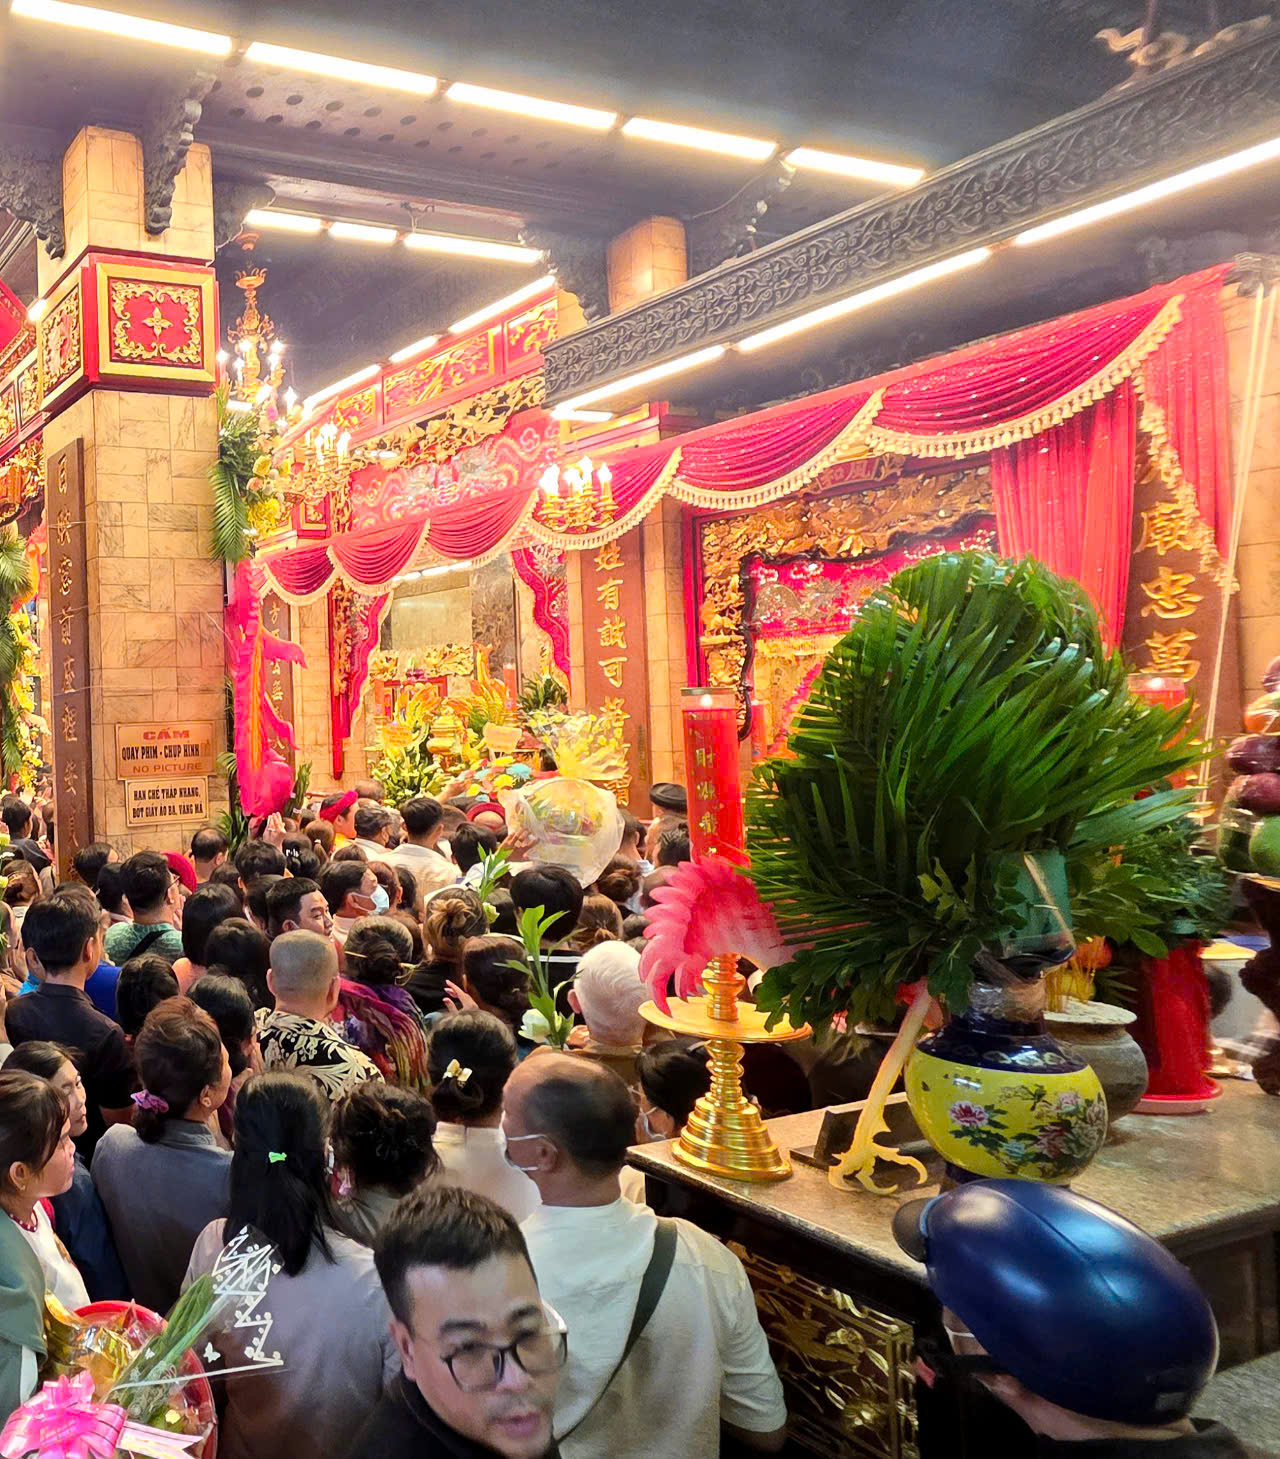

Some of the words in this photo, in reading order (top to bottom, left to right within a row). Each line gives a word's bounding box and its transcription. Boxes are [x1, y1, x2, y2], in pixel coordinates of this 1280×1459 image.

[143, 727, 190, 740] CẤM
[122, 746, 140, 760] QUAY
[141, 745, 158, 759] PHIM
[133, 765, 149, 774] NO
[153, 762, 204, 773] PICTURE
